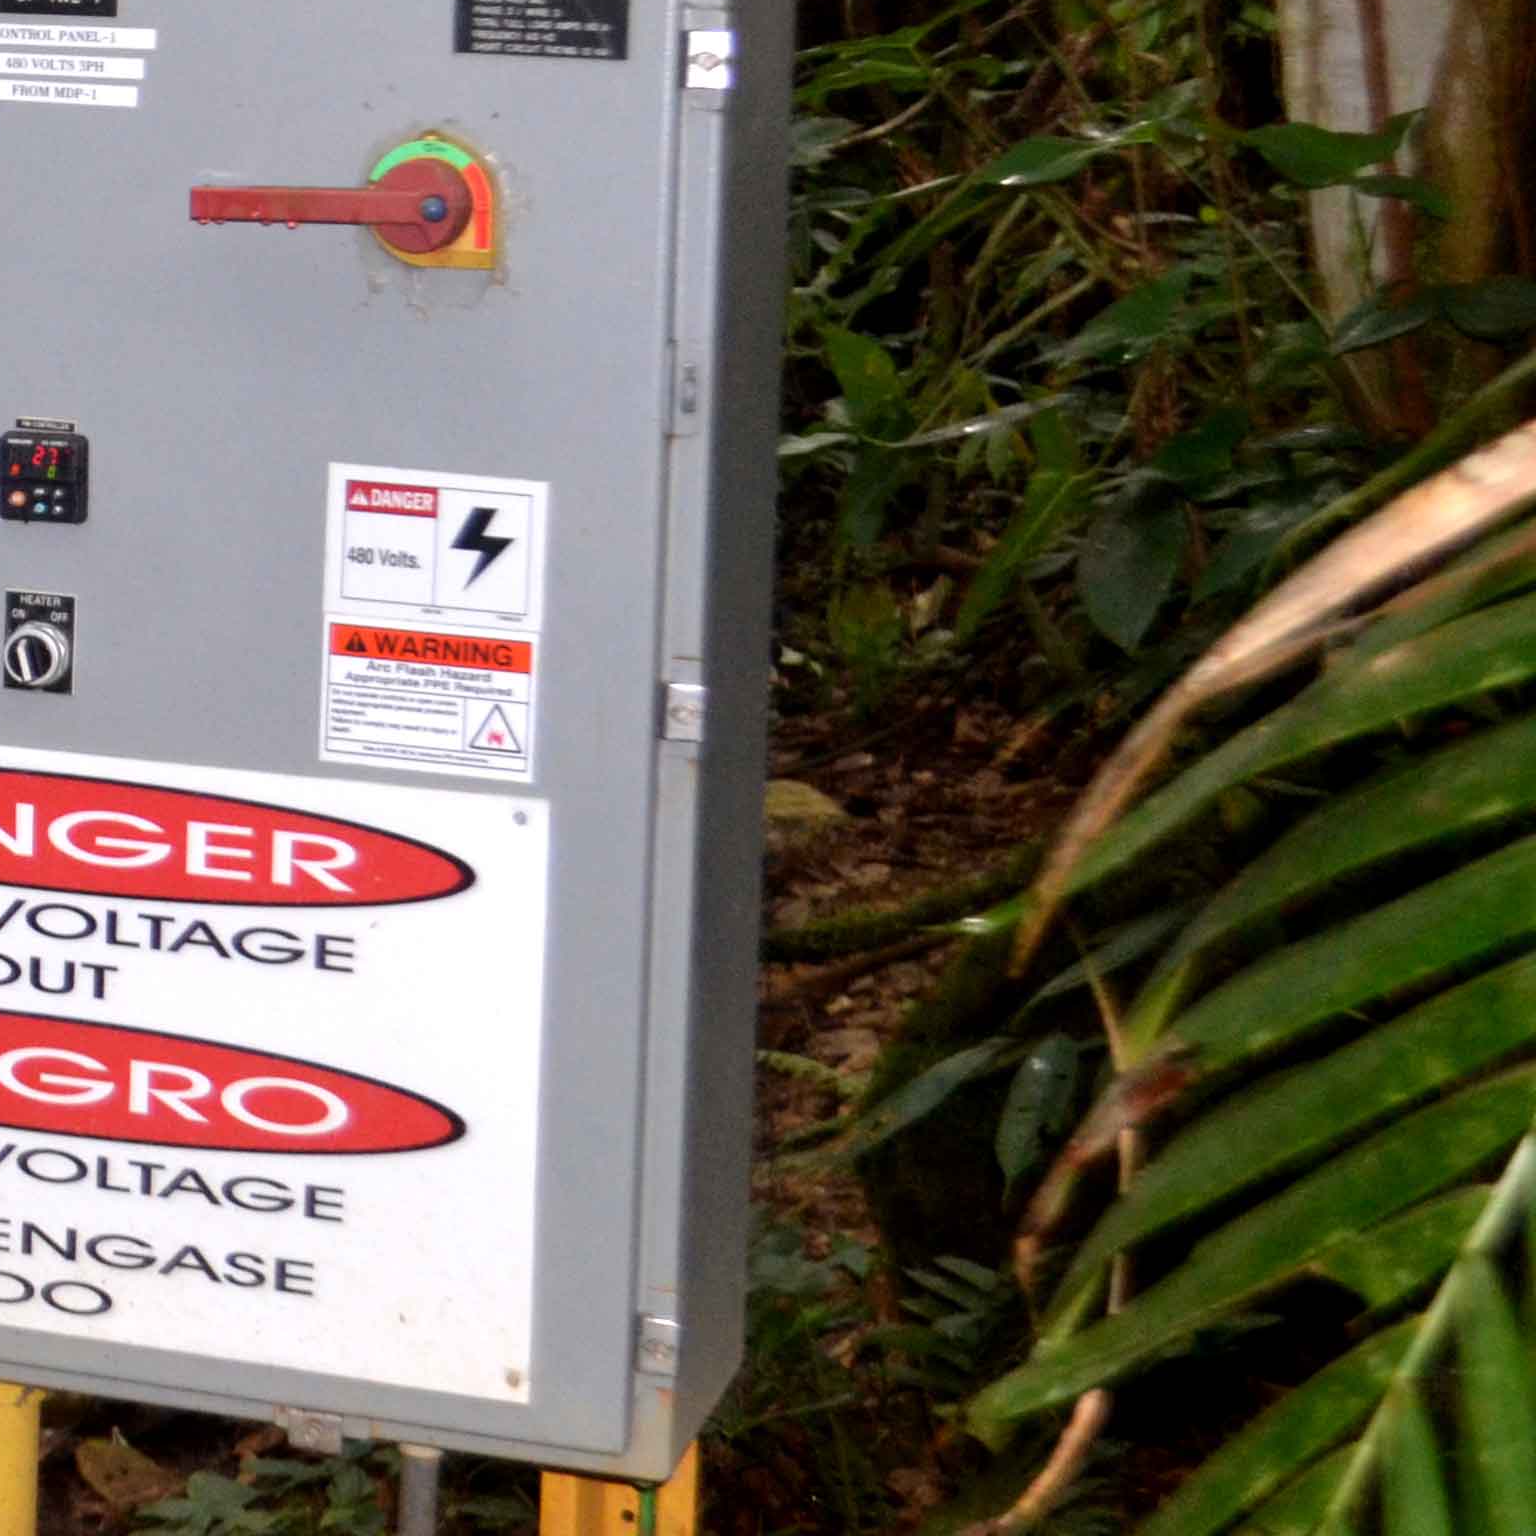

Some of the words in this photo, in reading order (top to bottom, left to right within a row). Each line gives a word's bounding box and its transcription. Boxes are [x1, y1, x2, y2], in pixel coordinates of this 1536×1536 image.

[58, 29, 117, 44] PANEL-1
[5, 56, 28, 70] 480
[31, 57, 75, 72] VOLTS
[78, 59, 105, 73] 3PH
[11, 83, 50, 98] FROM
[54, 85, 97, 100] MDP-1
[371, 488, 434, 510] DANGER
[346, 546, 374, 566] 480
[379, 548, 422, 569] Volts.
[19, 594, 62, 607] HEATER
[11, 607, 27, 619] ON
[50, 610, 69, 622] OFF
[373, 630, 513, 667] WARNING
[366, 660, 391, 673] Arc
[395, 663, 437, 677] Flash
[439, 667, 492, 682] Hazard
[344, 672, 421, 688] Appropriate
[423, 678, 451, 691] PPE
